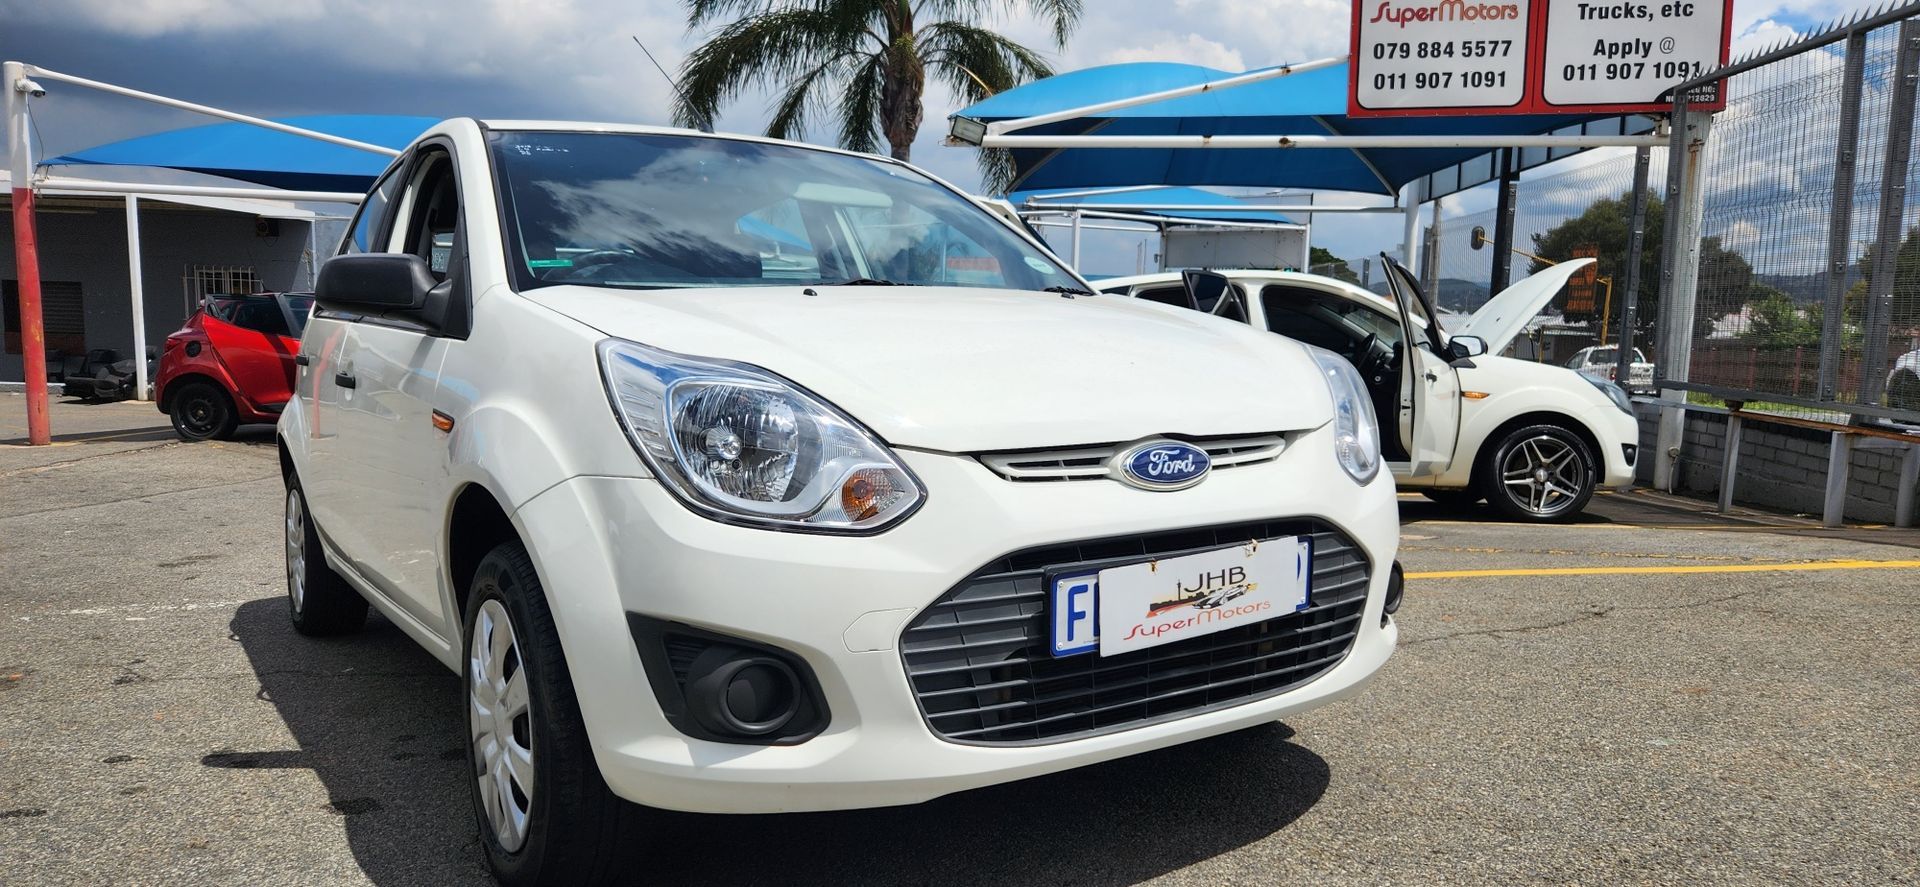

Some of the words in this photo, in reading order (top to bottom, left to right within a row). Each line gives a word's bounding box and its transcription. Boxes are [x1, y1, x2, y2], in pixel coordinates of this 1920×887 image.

[1370, 0, 1519, 28] SuperMotors
[1578, 2, 1654, 21] Trucks,
[1661, 1, 1694, 17] etc
[1373, 42, 1410, 59] 079
[1417, 41, 1454, 58] 884
[1462, 40, 1513, 57] 5577
[1593, 38, 1652, 59] Apply
[1659, 36, 1675, 54] @
[1373, 73, 1406, 90] 011
[1415, 72, 1452, 89] 907
[1461, 71, 1506, 88] 1091
[1563, 64, 1596, 81] 011
[1605, 63, 1645, 80] 907
[1653, 61, 1700, 78] 1091
[1148, 449, 1196, 475] Ford
[1184, 566, 1246, 593] JHB
[1123, 600, 1271, 641] SuperMotors
